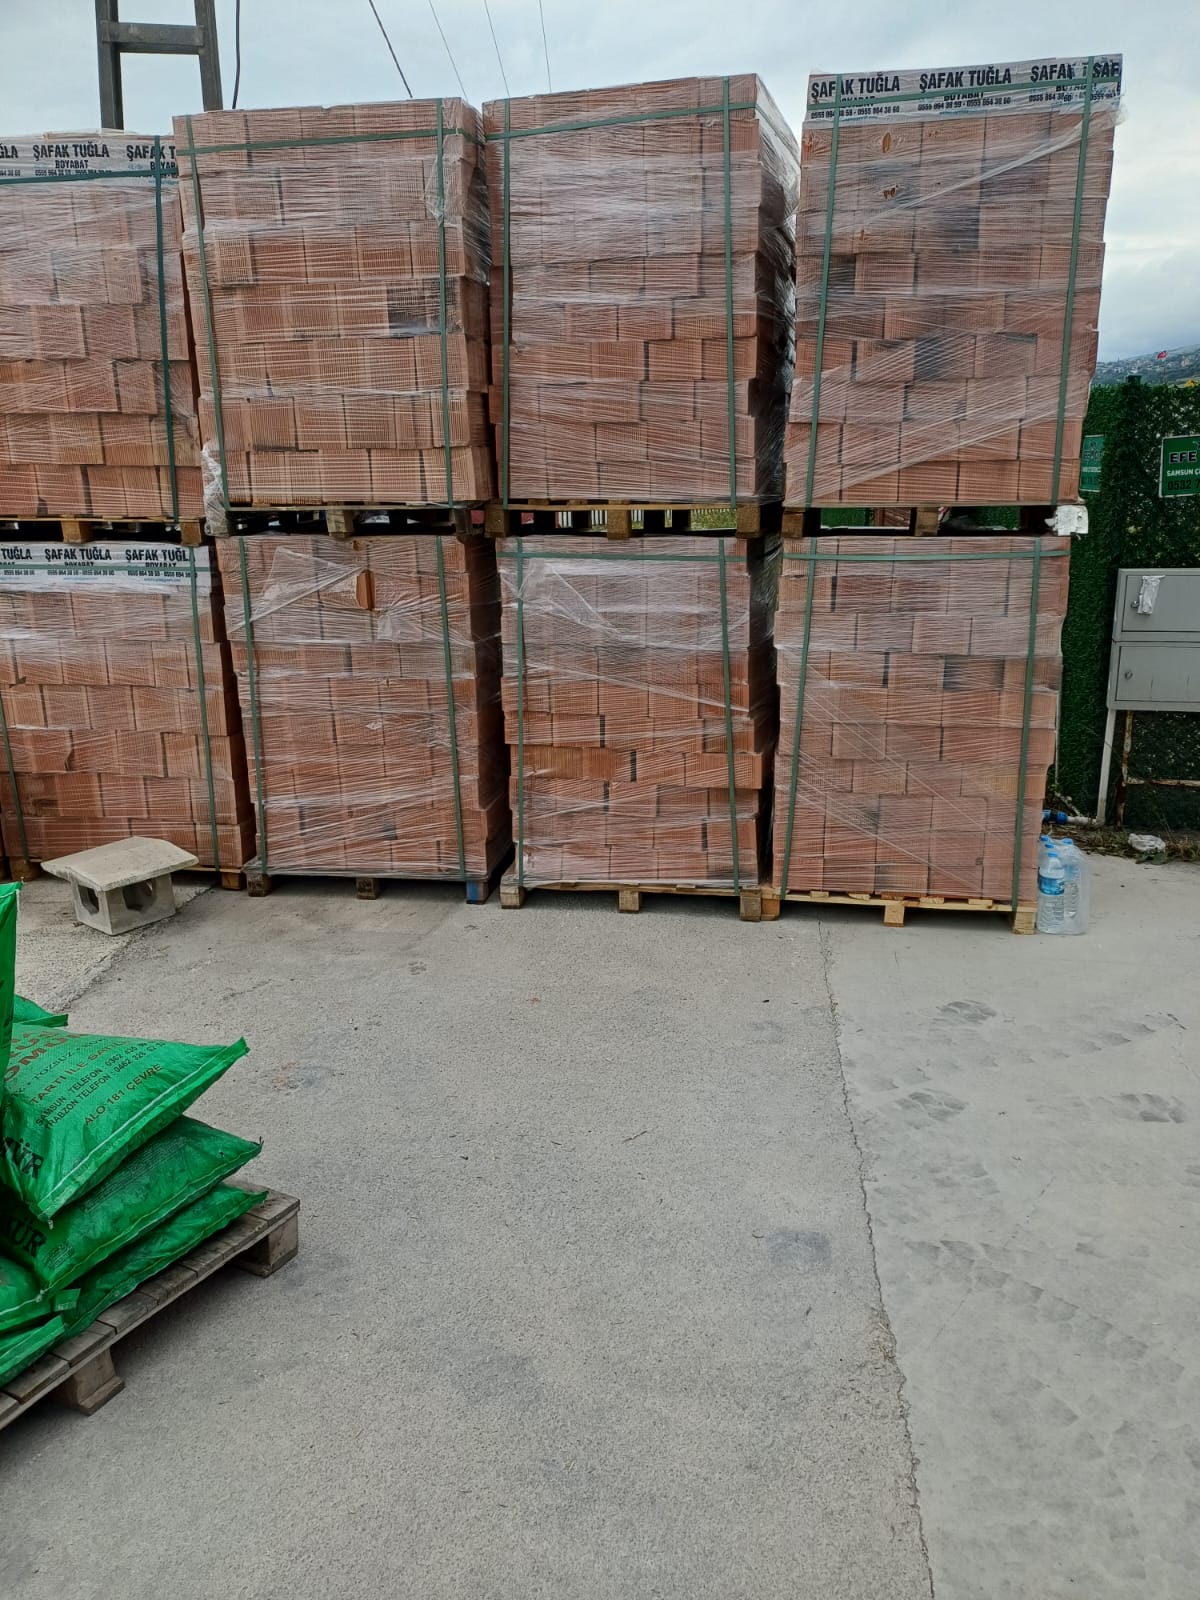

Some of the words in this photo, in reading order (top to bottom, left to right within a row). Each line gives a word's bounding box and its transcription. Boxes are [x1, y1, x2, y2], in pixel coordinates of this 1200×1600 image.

[811, 78, 854, 102] ŞAFAK
[858, 71, 900, 94] TUĞLA
[919, 71, 964, 94] ŞAFAK
[968, 66, 1012, 87] TUĞLA
[32, 144, 70, 161] ŞAFAK
[72, 141, 110, 158] TUĞLA
[55, 159, 89, 169] BOYABAT
[1169, 450, 1197, 464] EFE
[1166, 468, 1194, 477] SAMSUN
[1167, 480, 1192, 491] 0532
[1, 546, 33, 560] TUĞLA
[44, 548, 78, 562] ŞAFAK
[79, 546, 112, 560] TUĞLA
[125, 549, 160, 563] ŞAFAK
[161, 547, 193, 561] TUĞL
[30, 1075, 66, 1105] TARTI
[77, 1074, 112, 1100] TELEFON
[84, 1105, 107, 1126] ALO
[106, 1089, 125, 1105] 181
[125, 1063, 163, 1092] ÇEVRE
[35, 1095, 67, 1127] SAMSUN
[67, 1067, 103, 1094] TELEFON
